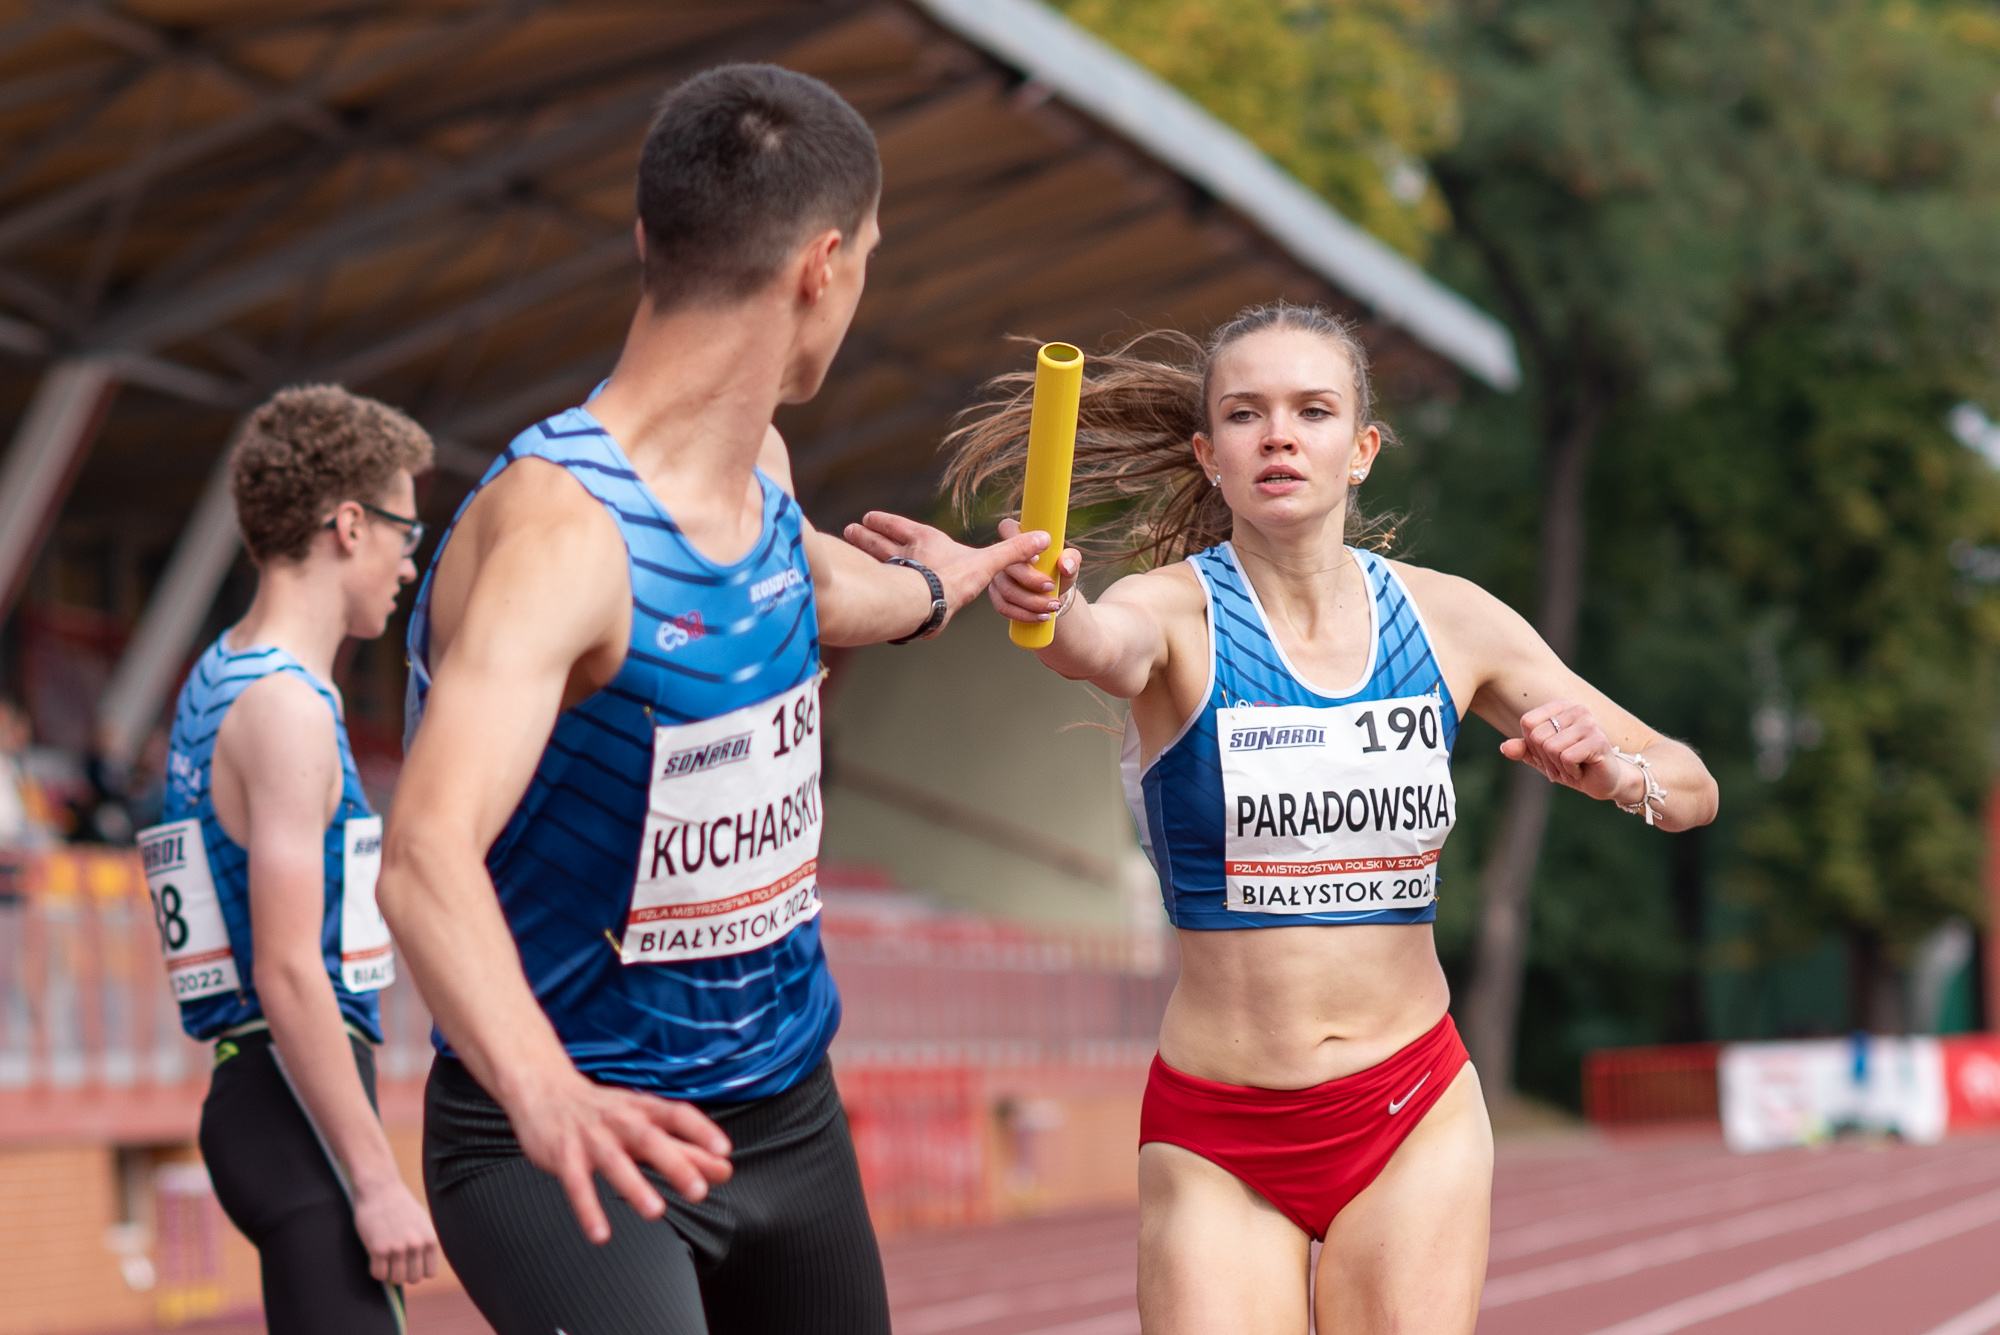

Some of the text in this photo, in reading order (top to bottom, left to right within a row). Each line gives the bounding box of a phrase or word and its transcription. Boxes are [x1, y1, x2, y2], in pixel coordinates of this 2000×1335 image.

[772, 684, 815, 758] 186
[1229, 726, 1327, 750] SONAROL
[1355, 705, 1438, 753] 190
[664, 735, 752, 775] SONAROL
[650, 772, 817, 879] KUCHARSKI
[1237, 784, 1450, 838] PARADOWSKA
[1233, 863, 1264, 874] PZLA
[1265, 860, 1343, 875] MISTRZOSTWA
[1345, 861, 1383, 871] POLSKI
[1385, 859, 1397, 869] W
[637, 907, 669, 921] PZLA
[671, 895, 750, 918] MISTRZOSTWA
[1242, 881, 1384, 906] BIAŁYSTOK
[640, 906, 779, 953] BIAŁYSTOK
[178, 968, 224, 994] 2022
